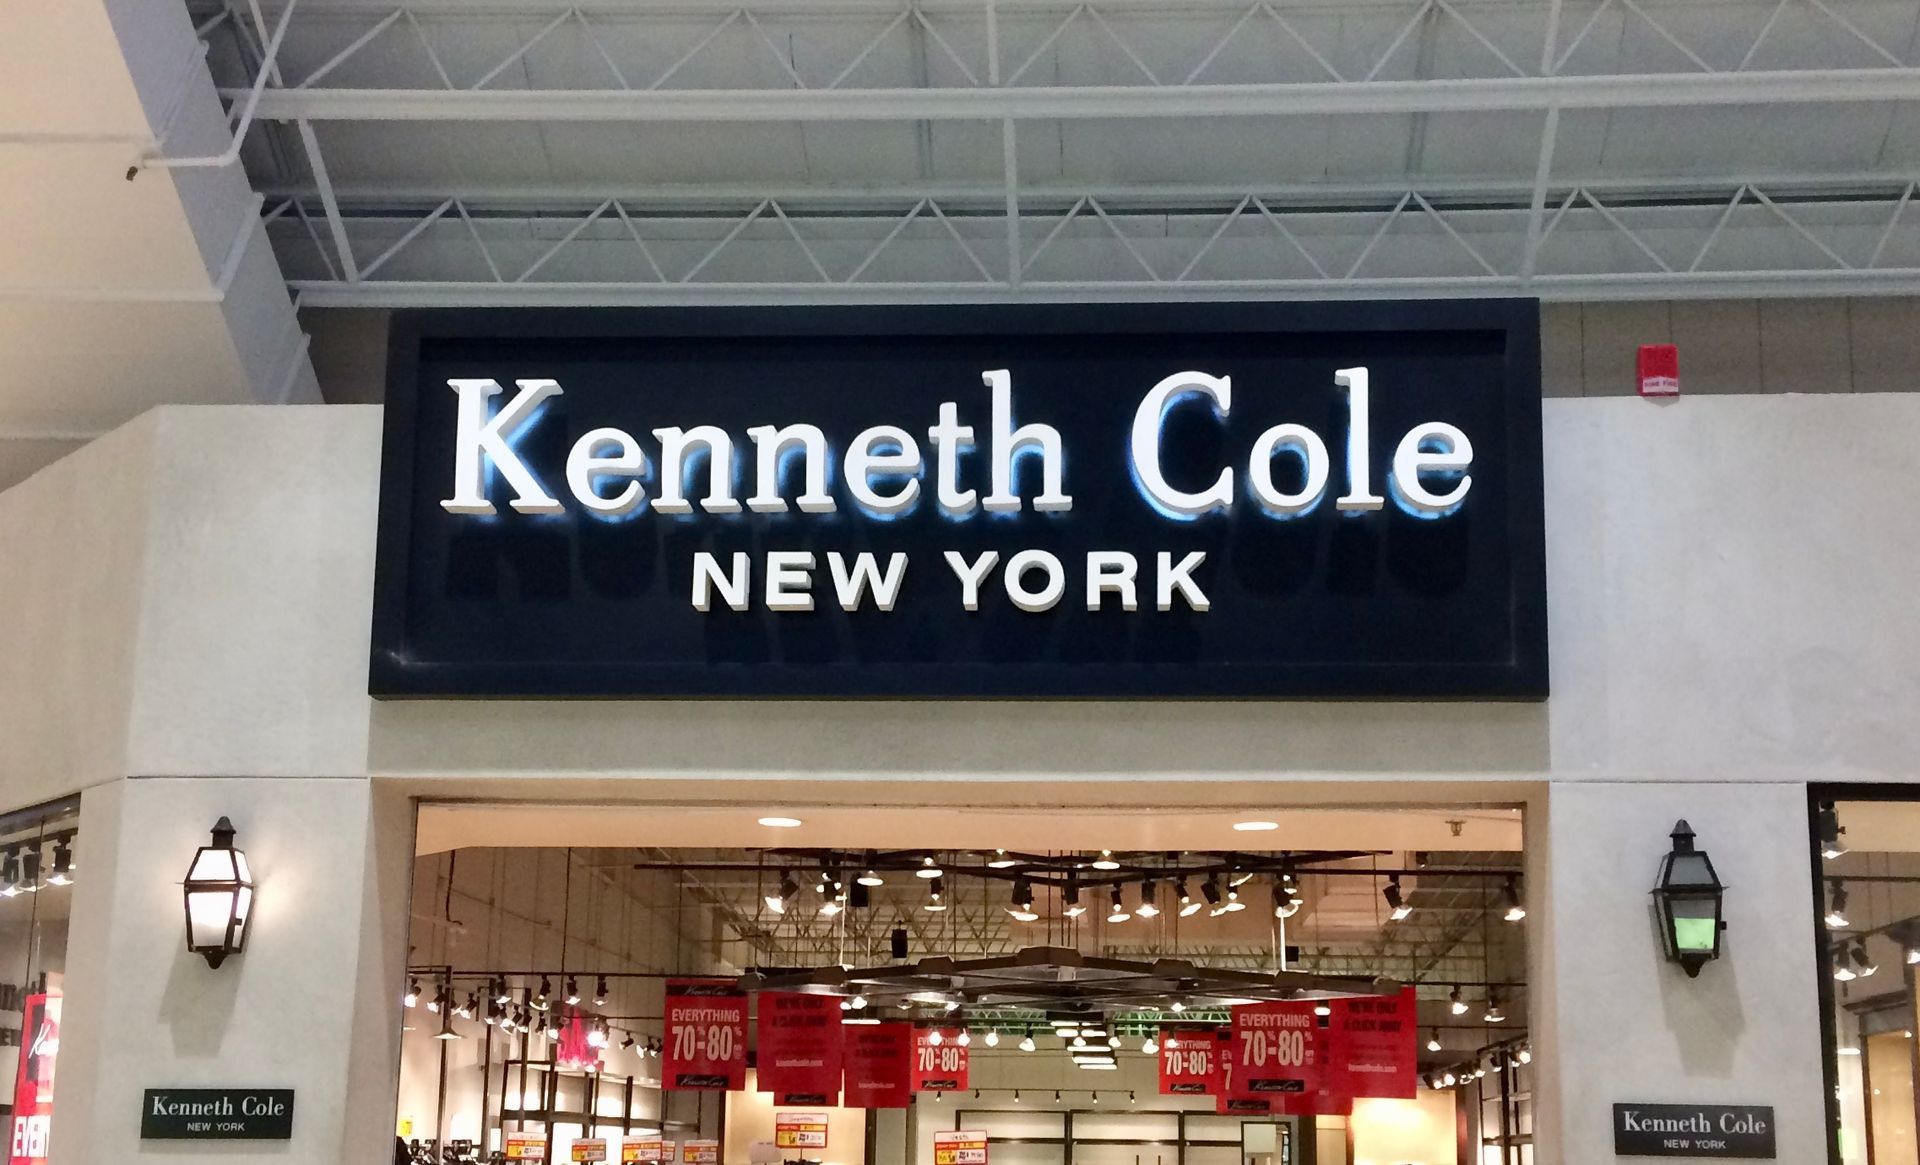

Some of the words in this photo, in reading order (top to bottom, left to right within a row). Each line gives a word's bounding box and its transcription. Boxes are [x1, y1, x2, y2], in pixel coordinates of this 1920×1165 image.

[440, 369, 1073, 514] Kenneth
[1131, 367, 1474, 512] Cole
[692, 551, 908, 612] NEW
[944, 549, 1210, 613] YORK
[672, 1008, 740, 1022] EVERYTHING
[1240, 1013, 1310, 1027] EVERYTHING
[152, 1096, 233, 1116] Kenneth
[241, 1096, 285, 1116] Cole
[187, 1122, 211, 1131] NEW
[216, 1122, 245, 1131] YORK
[1623, 1111, 1711, 1133] Kenneth
[1719, 1112, 1766, 1134] Cole
[1664, 1139, 1689, 1149] NEW
[1695, 1140, 1727, 1150] YORK
